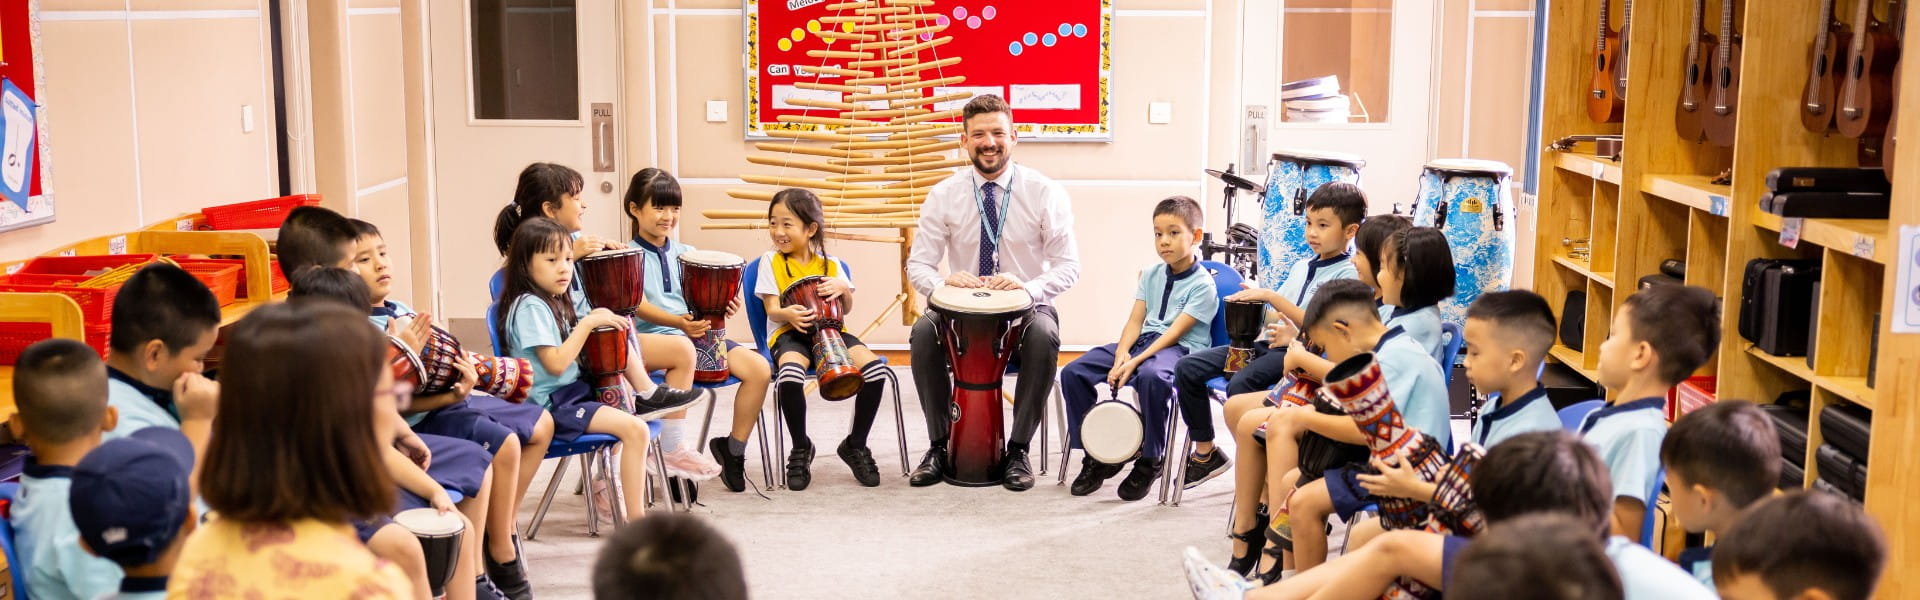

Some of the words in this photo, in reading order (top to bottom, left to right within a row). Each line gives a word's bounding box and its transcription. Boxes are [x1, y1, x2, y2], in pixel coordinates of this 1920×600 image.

[769, 65, 788, 74] Can
[593, 108, 612, 117] PULL
[1248, 110, 1265, 119] PULL
